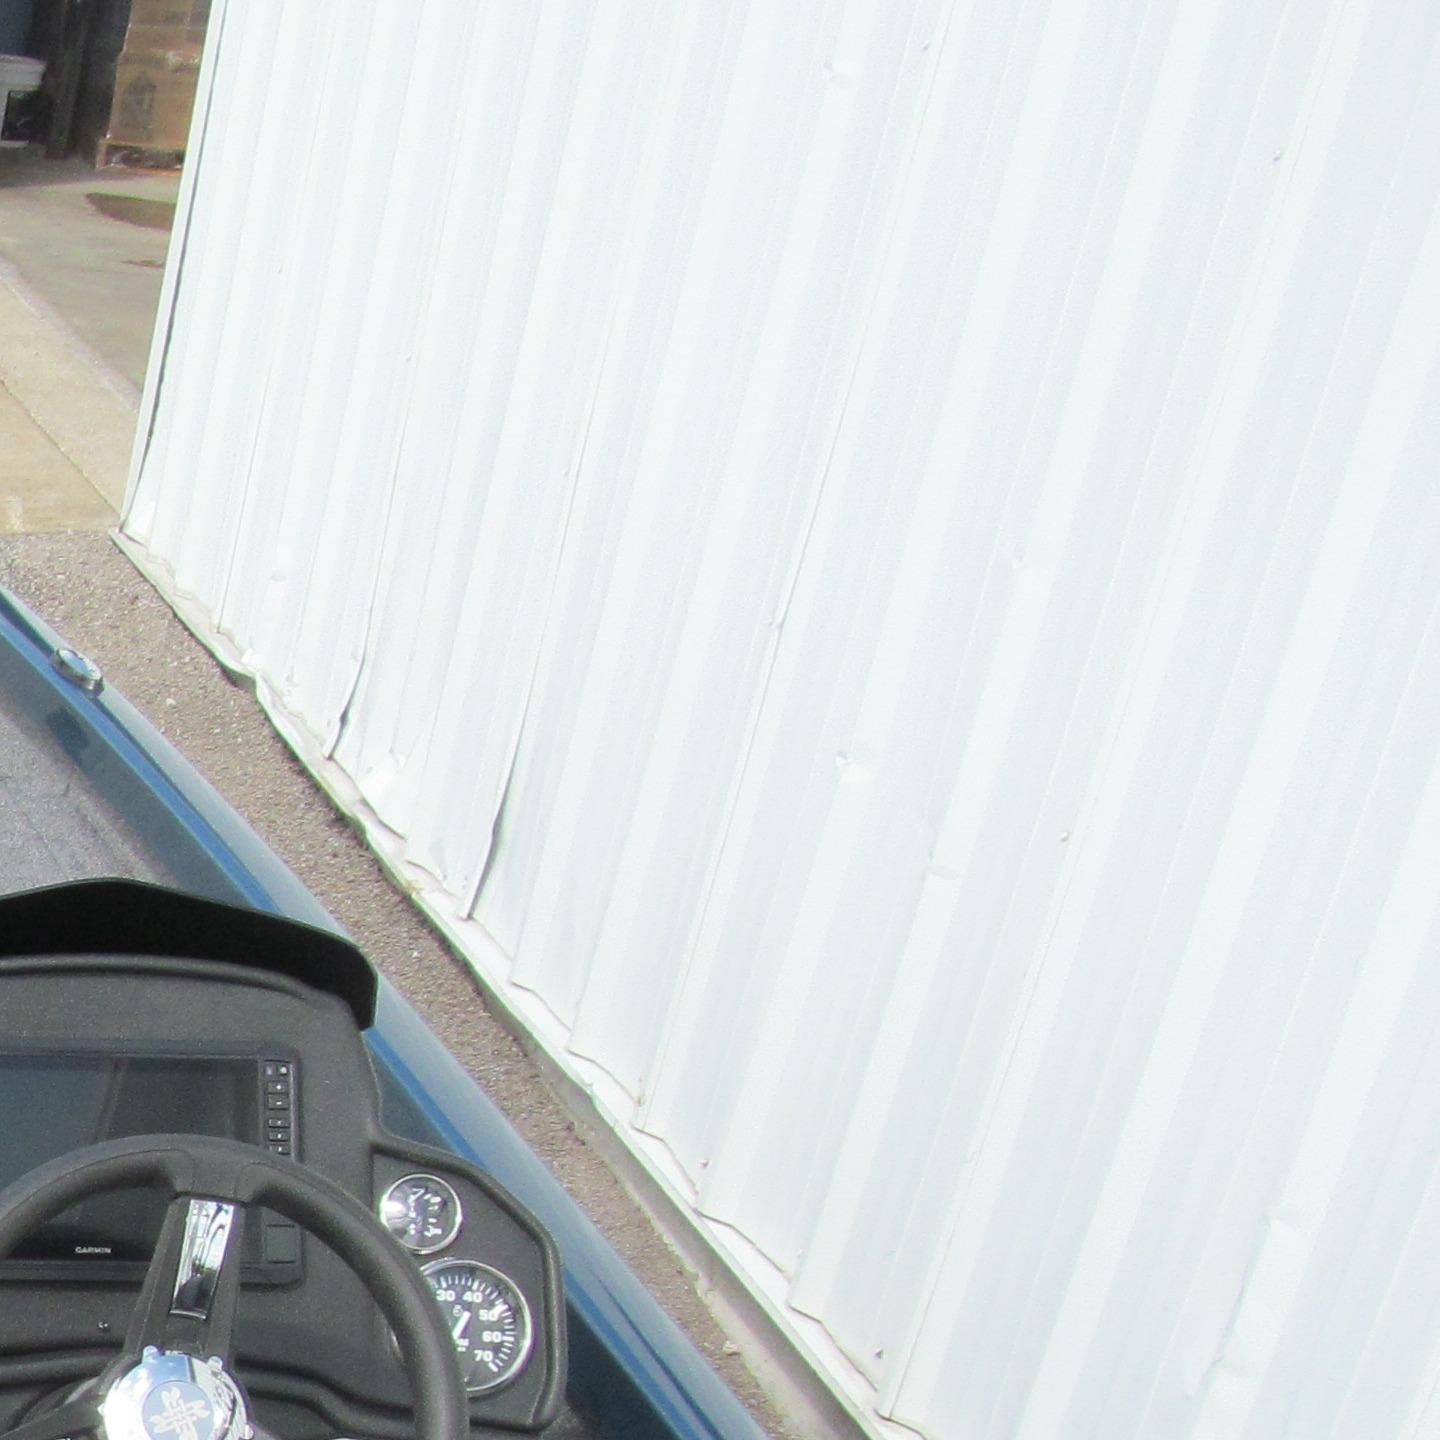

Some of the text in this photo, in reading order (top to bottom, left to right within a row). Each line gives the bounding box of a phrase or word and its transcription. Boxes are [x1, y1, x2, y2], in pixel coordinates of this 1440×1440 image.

[436, 1289, 456, 1302] 30
[462, 1291, 483, 1303] 40
[478, 1309, 499, 1321] 50
[482, 1330, 502, 1343] 60
[473, 1349, 494, 1361] 70
